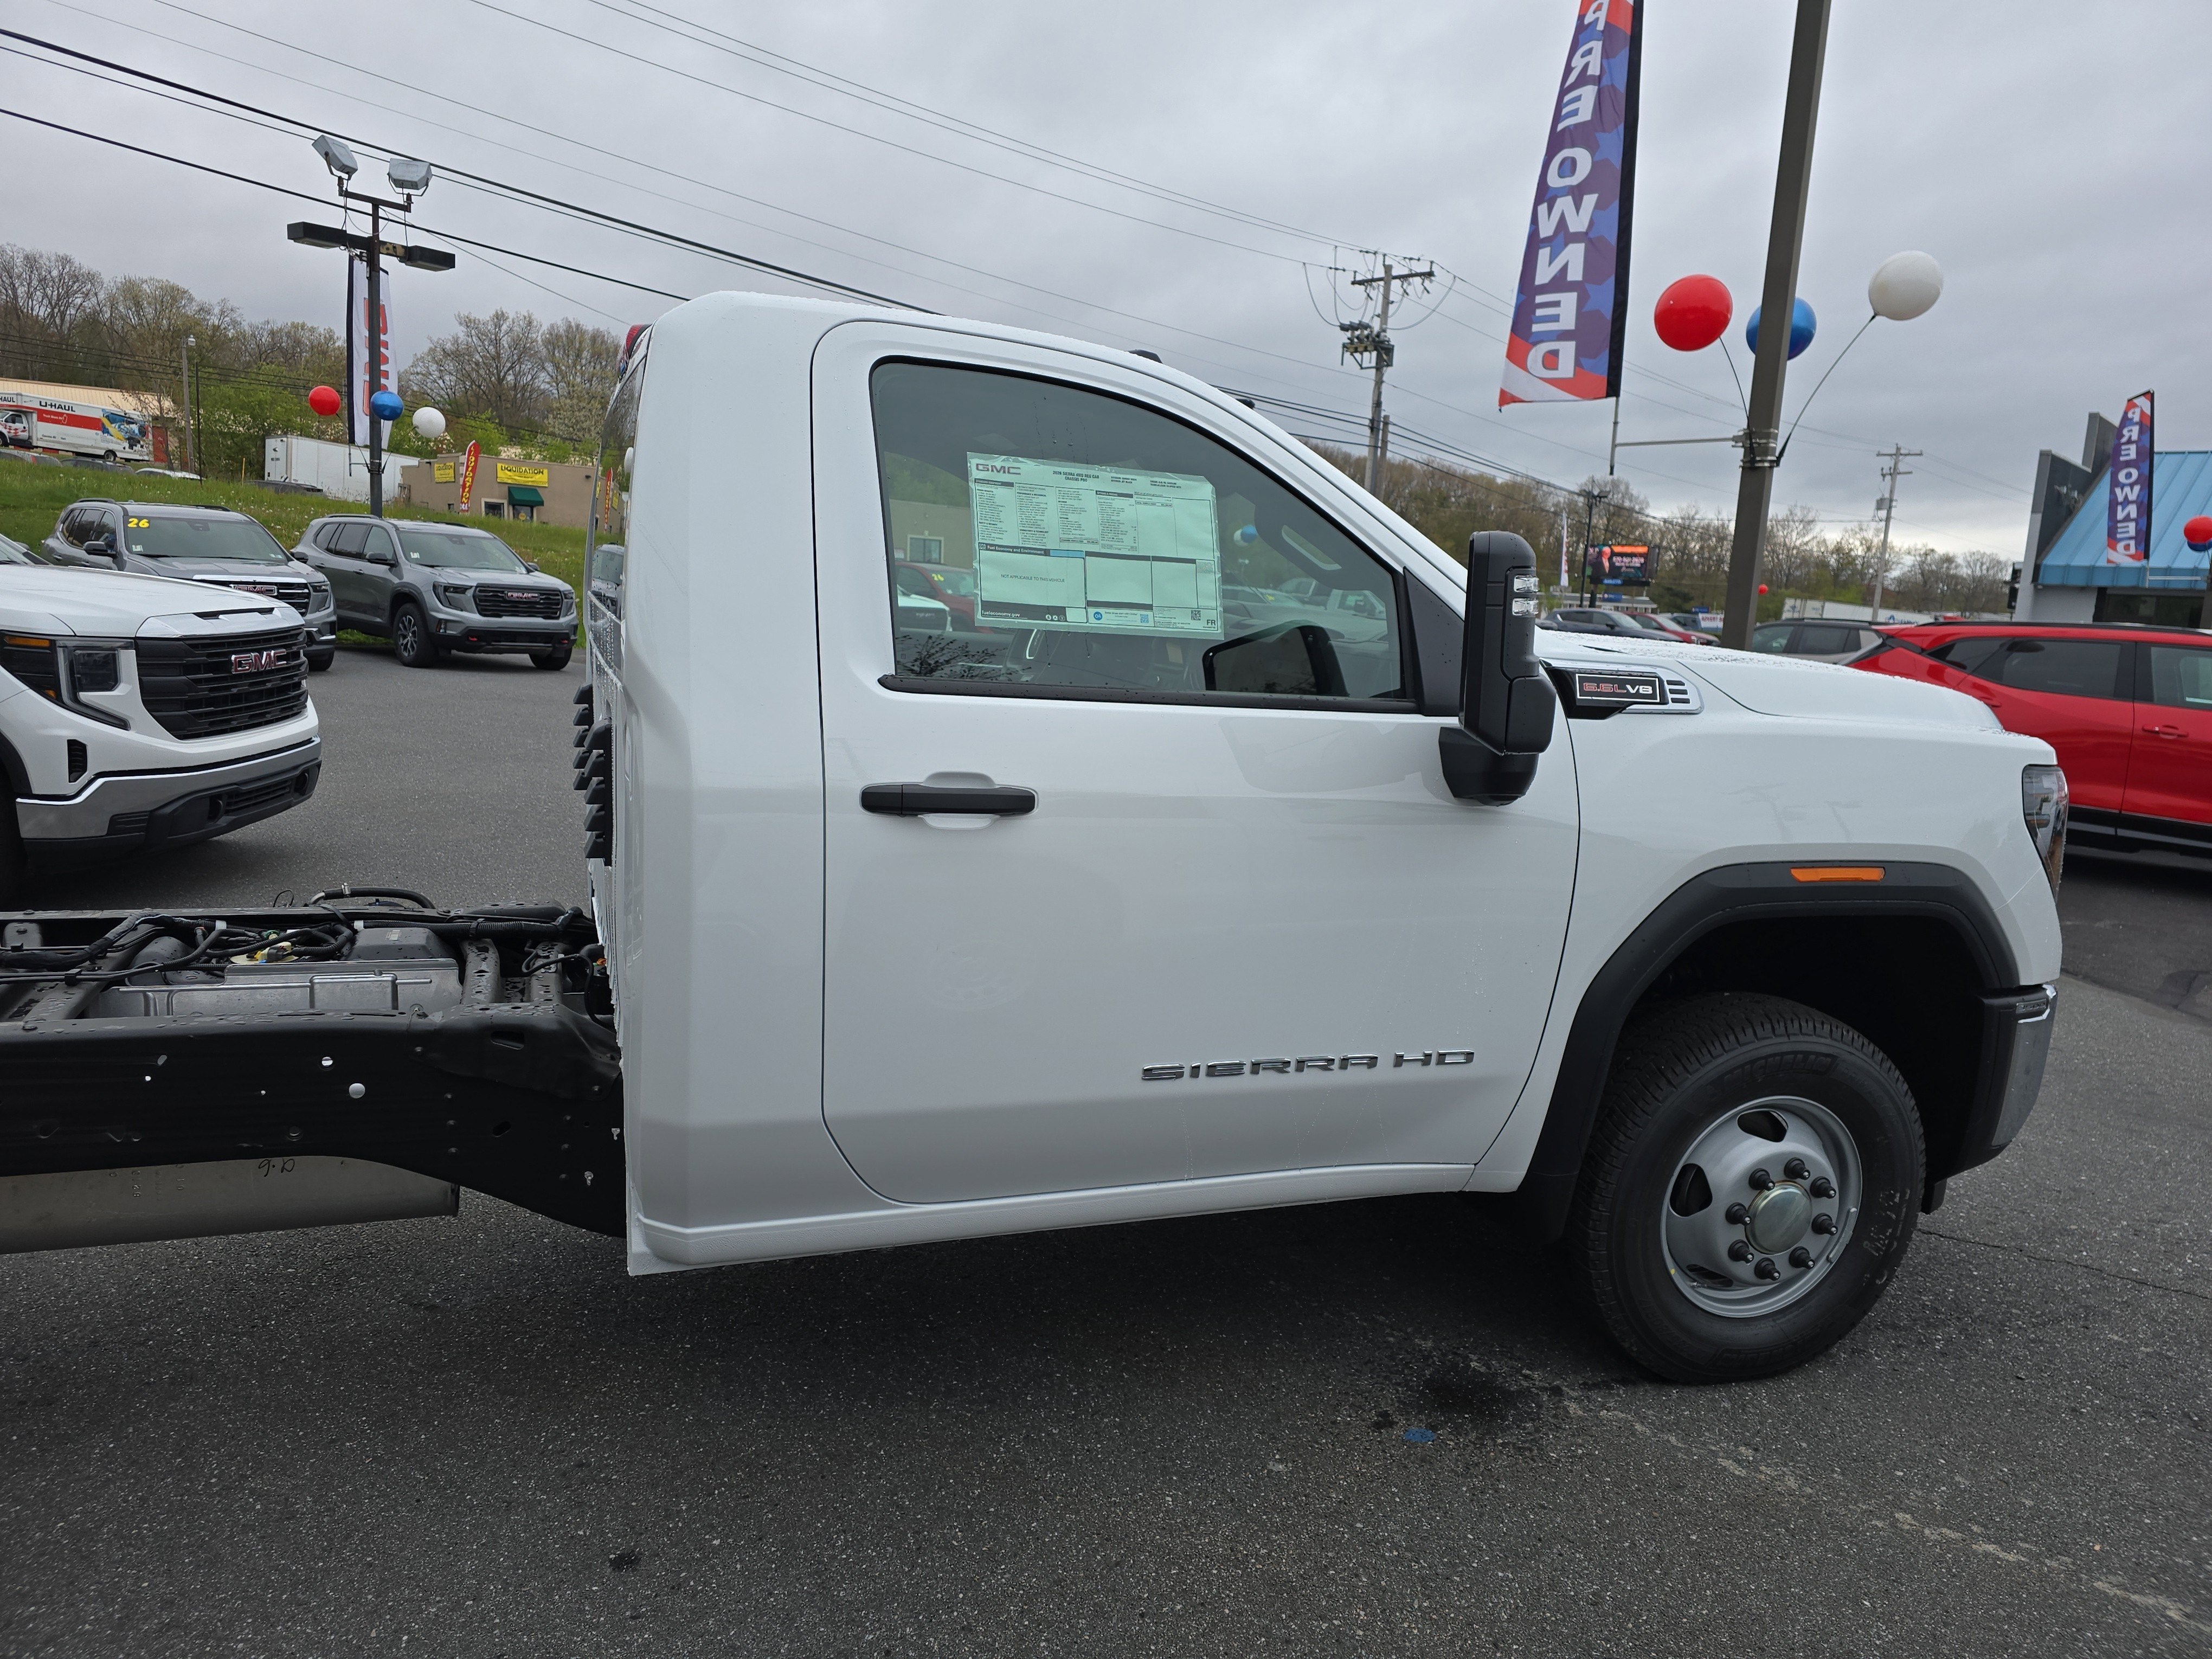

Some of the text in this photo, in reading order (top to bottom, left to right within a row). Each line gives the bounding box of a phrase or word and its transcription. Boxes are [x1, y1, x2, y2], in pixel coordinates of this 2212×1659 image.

[40, 401, 75, 412] U-HAUL
[462, 446, 475, 503] LIQUIDATION
[500, 465, 544, 475] LIQUIDATION
[976, 464, 1021, 475] GMC
[127, 518, 149, 528] 26
[507, 591, 538, 600] GMC
[231, 648, 287, 674] GMC
[1141, 1049, 1475, 1081] SIERRA HD
